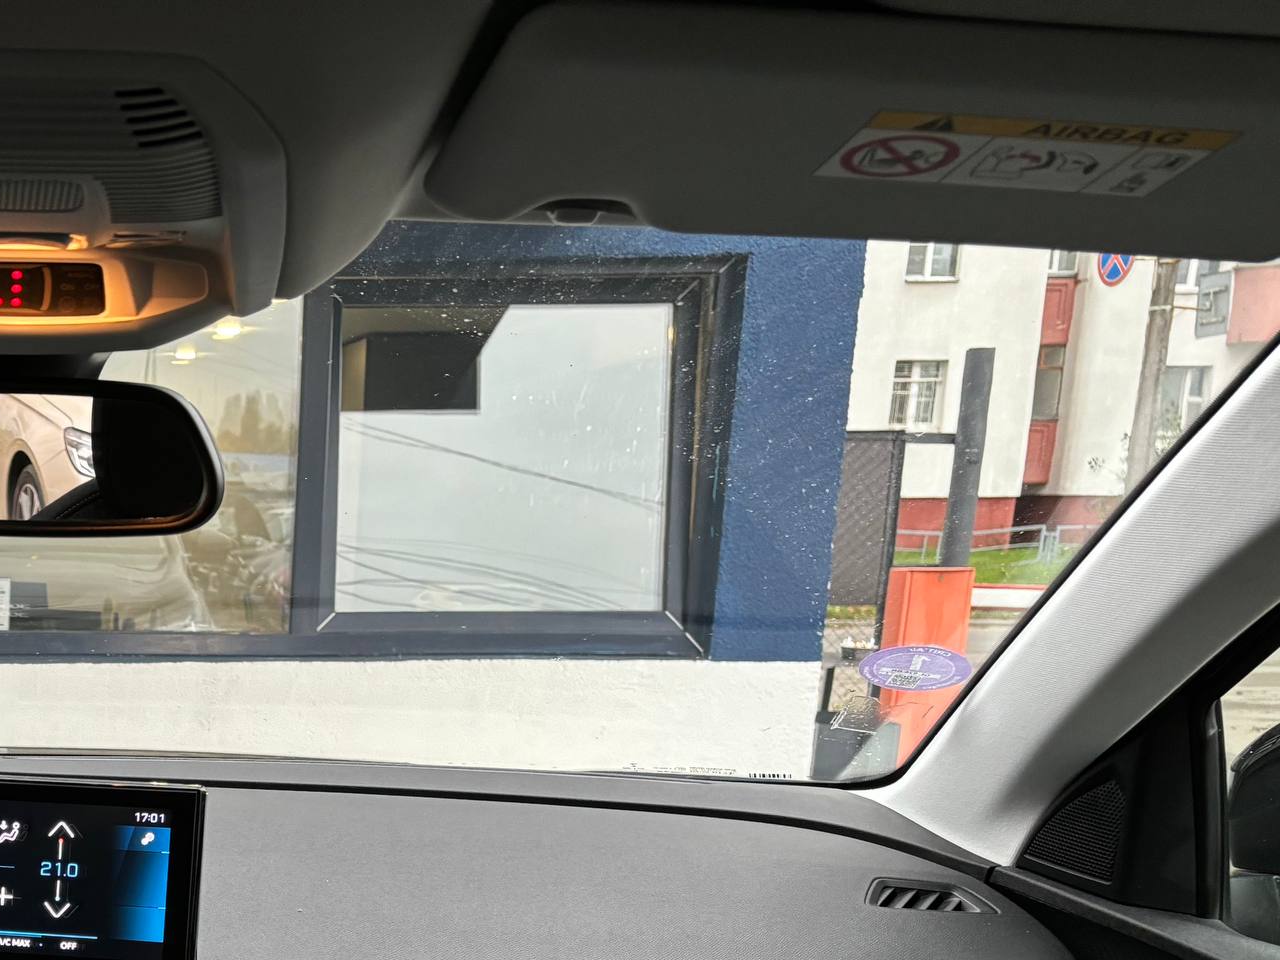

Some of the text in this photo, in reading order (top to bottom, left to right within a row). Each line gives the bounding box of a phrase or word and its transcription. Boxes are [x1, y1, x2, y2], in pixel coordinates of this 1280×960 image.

[1024, 122, 1191, 145] AIRBAG
[134, 812, 165, 824] 17:01
[40, 861, 79, 878] 21.0
[11, 938, 31, 948] MAX
[60, 941, 77, 951] OFF
